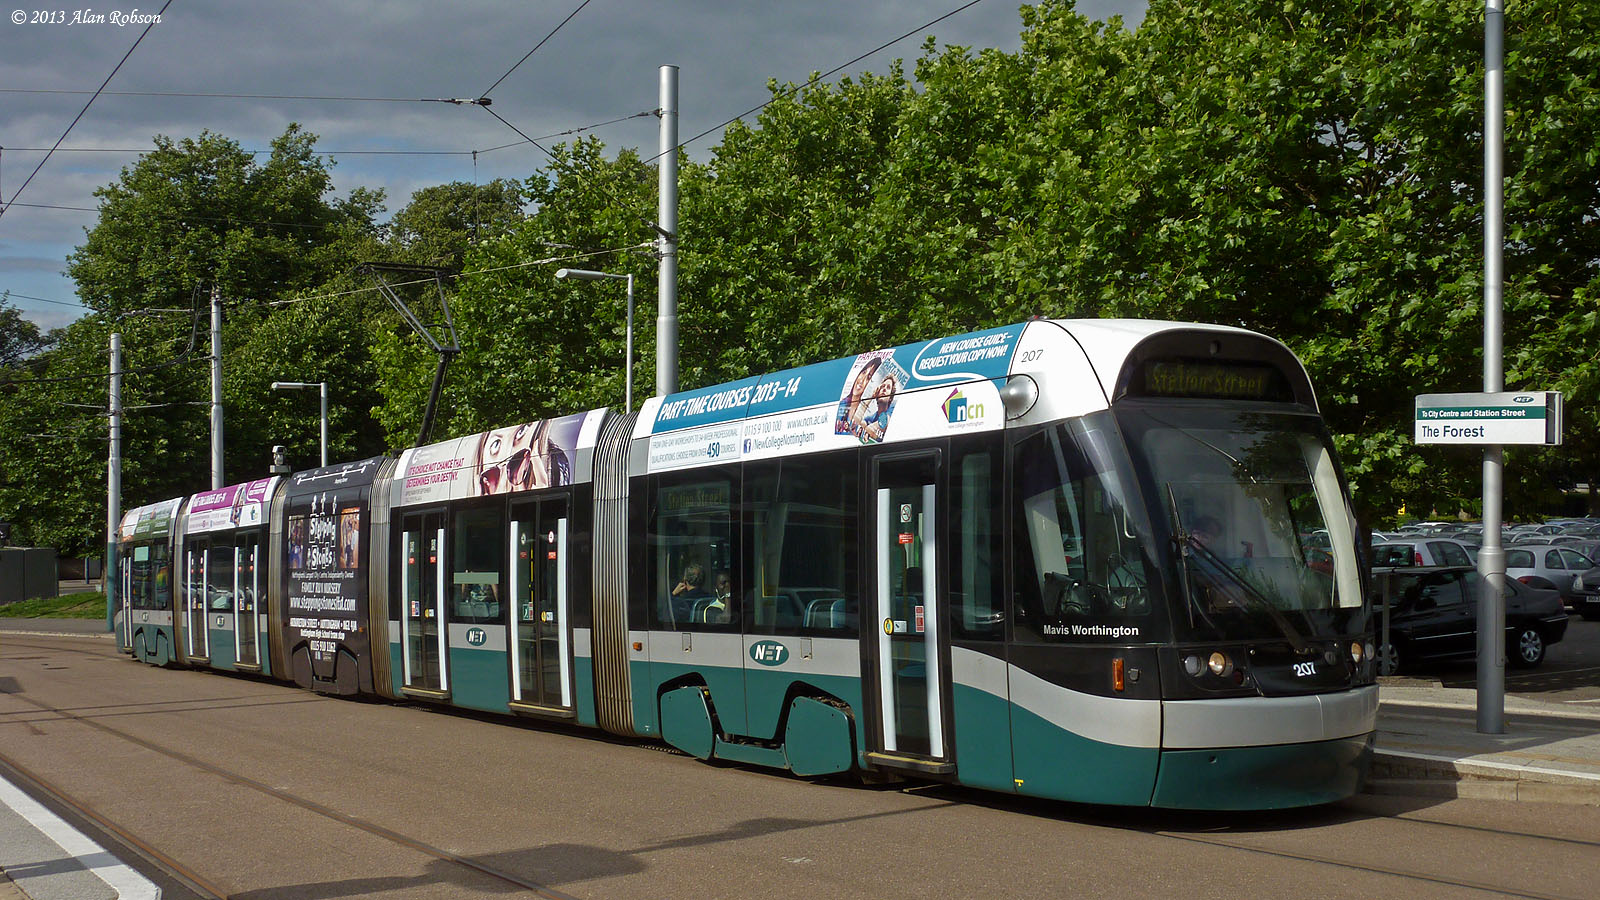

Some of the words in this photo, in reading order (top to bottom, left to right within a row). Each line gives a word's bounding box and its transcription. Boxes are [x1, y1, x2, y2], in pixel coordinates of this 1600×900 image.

[940, 341, 958, 354] NEW
[958, 336, 984, 350] COURSE
[919, 354, 950, 370] REQUEST
[948, 351, 969, 366] YOUR
[968, 348, 986, 363] COPY
[985, 345, 1009, 360] NOW!
[1021, 349, 1044, 363] 207
[657, 395, 710, 422] PART-TIME
[709, 385, 753, 412] COURSES
[956, 402, 985, 421] ncn
[787, 412, 829, 429] www.ncn.ac.uk
[1428, 410, 1438, 419] City
[1439, 409, 1459, 417] Centre
[1473, 409, 1500, 417] Station
[1501, 409, 1526, 417] Street
[1422, 425, 1440, 437] The
[1443, 425, 1485, 437] Forest
[707, 442, 720, 458] 450
[1043, 625, 1070, 636] Mavis
[1072, 624, 1139, 638] Worthington
[754, 644, 784, 662] NET
[1293, 663, 1317, 677] 207
